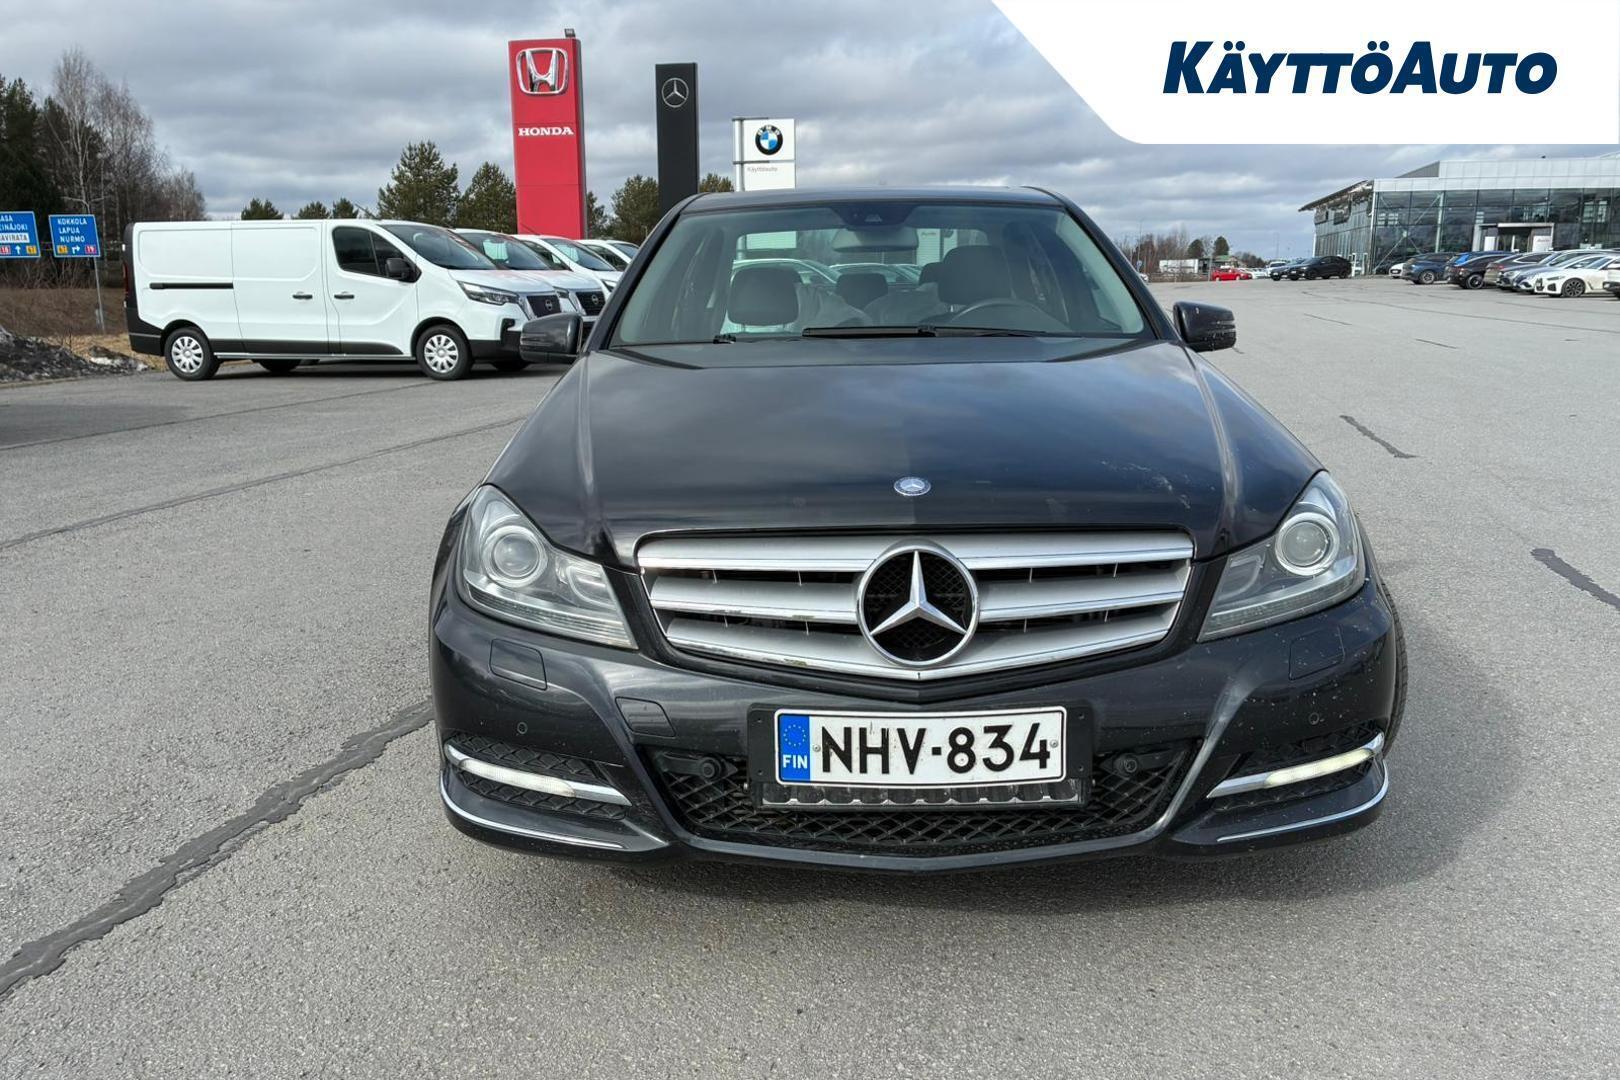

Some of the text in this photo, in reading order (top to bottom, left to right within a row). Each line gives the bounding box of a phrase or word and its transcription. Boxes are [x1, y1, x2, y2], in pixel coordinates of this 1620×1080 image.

[517, 126, 575, 136] HONDA
[0, 214, 14, 222] ASA
[60, 235, 86, 243] NURMO
[783, 722, 1051, 775] FIN NHV-834
